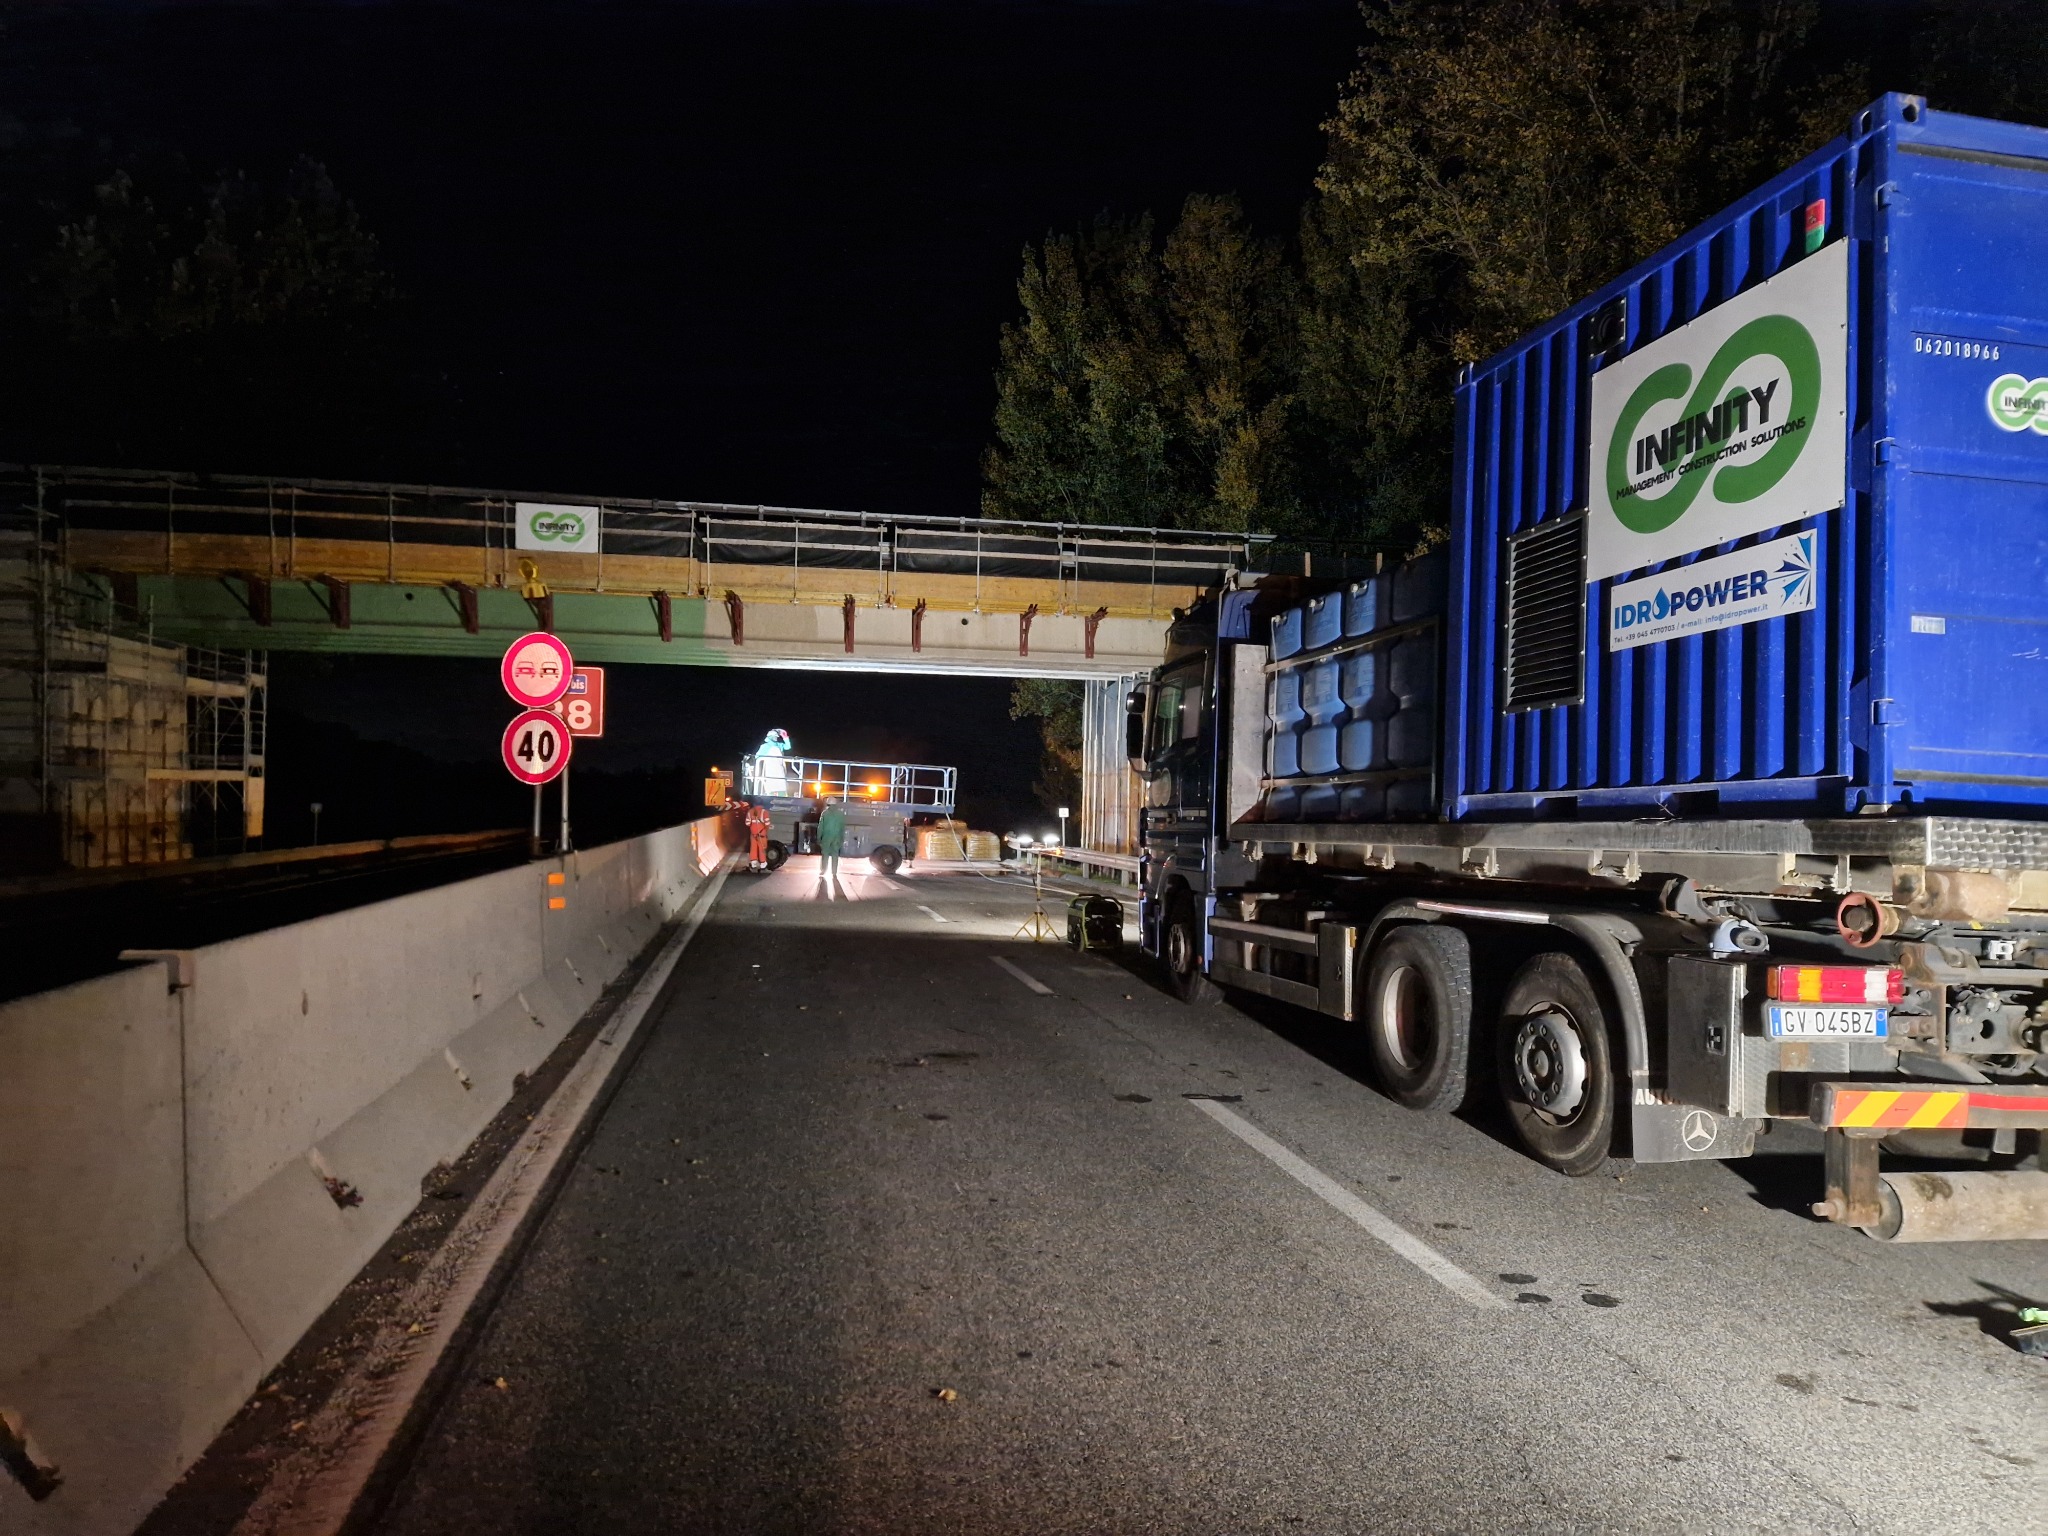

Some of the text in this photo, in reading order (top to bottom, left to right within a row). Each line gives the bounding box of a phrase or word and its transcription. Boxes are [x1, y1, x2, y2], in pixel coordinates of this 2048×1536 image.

[1915, 337, 1999, 360] 062018966
[2004, 396, 2048, 410] INFINIT
[1636, 378, 1780, 475] INFINITY
[1616, 416, 1806, 500] MANAGEMENT CONSTRUCTION SOLUTIONS
[538, 522, 576, 531] INFINITY
[1705, 603, 1768, 624] info@idropower.it
[517, 730, 554, 762] 40
[1785, 1011, 1806, 1033] GV
[1815, 1011, 1874, 1033] 045BZ
